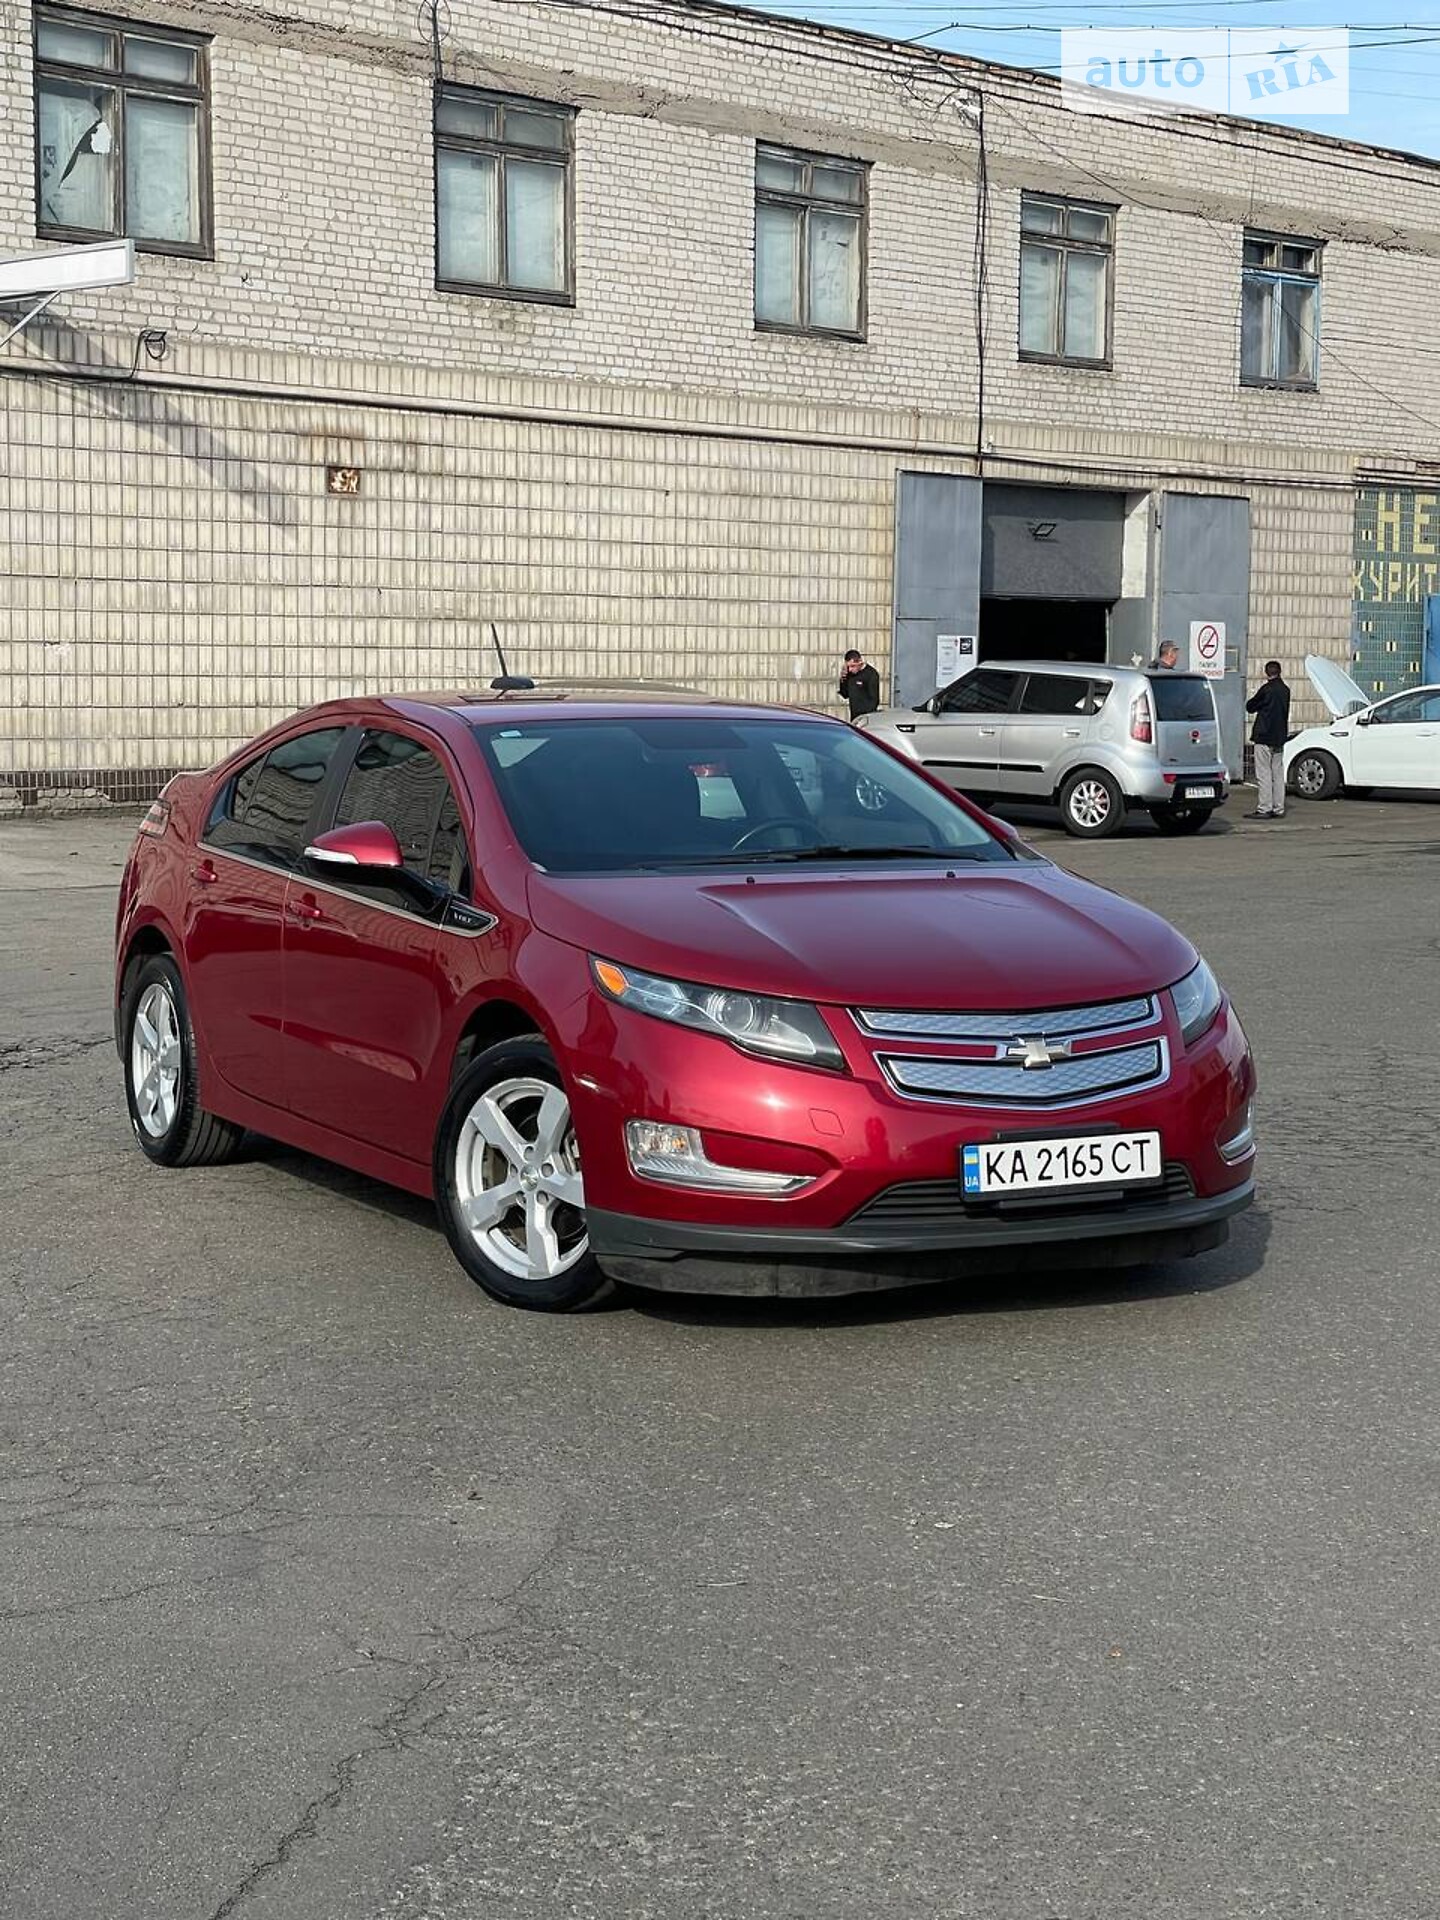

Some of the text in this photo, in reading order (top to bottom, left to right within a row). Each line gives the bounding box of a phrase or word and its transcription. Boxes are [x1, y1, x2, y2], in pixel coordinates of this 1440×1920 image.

[1376, 492, 1437, 554] НЕ
[965, 1176, 979, 1187] UA
[986, 1139, 1151, 1185] KA 2165 CT
